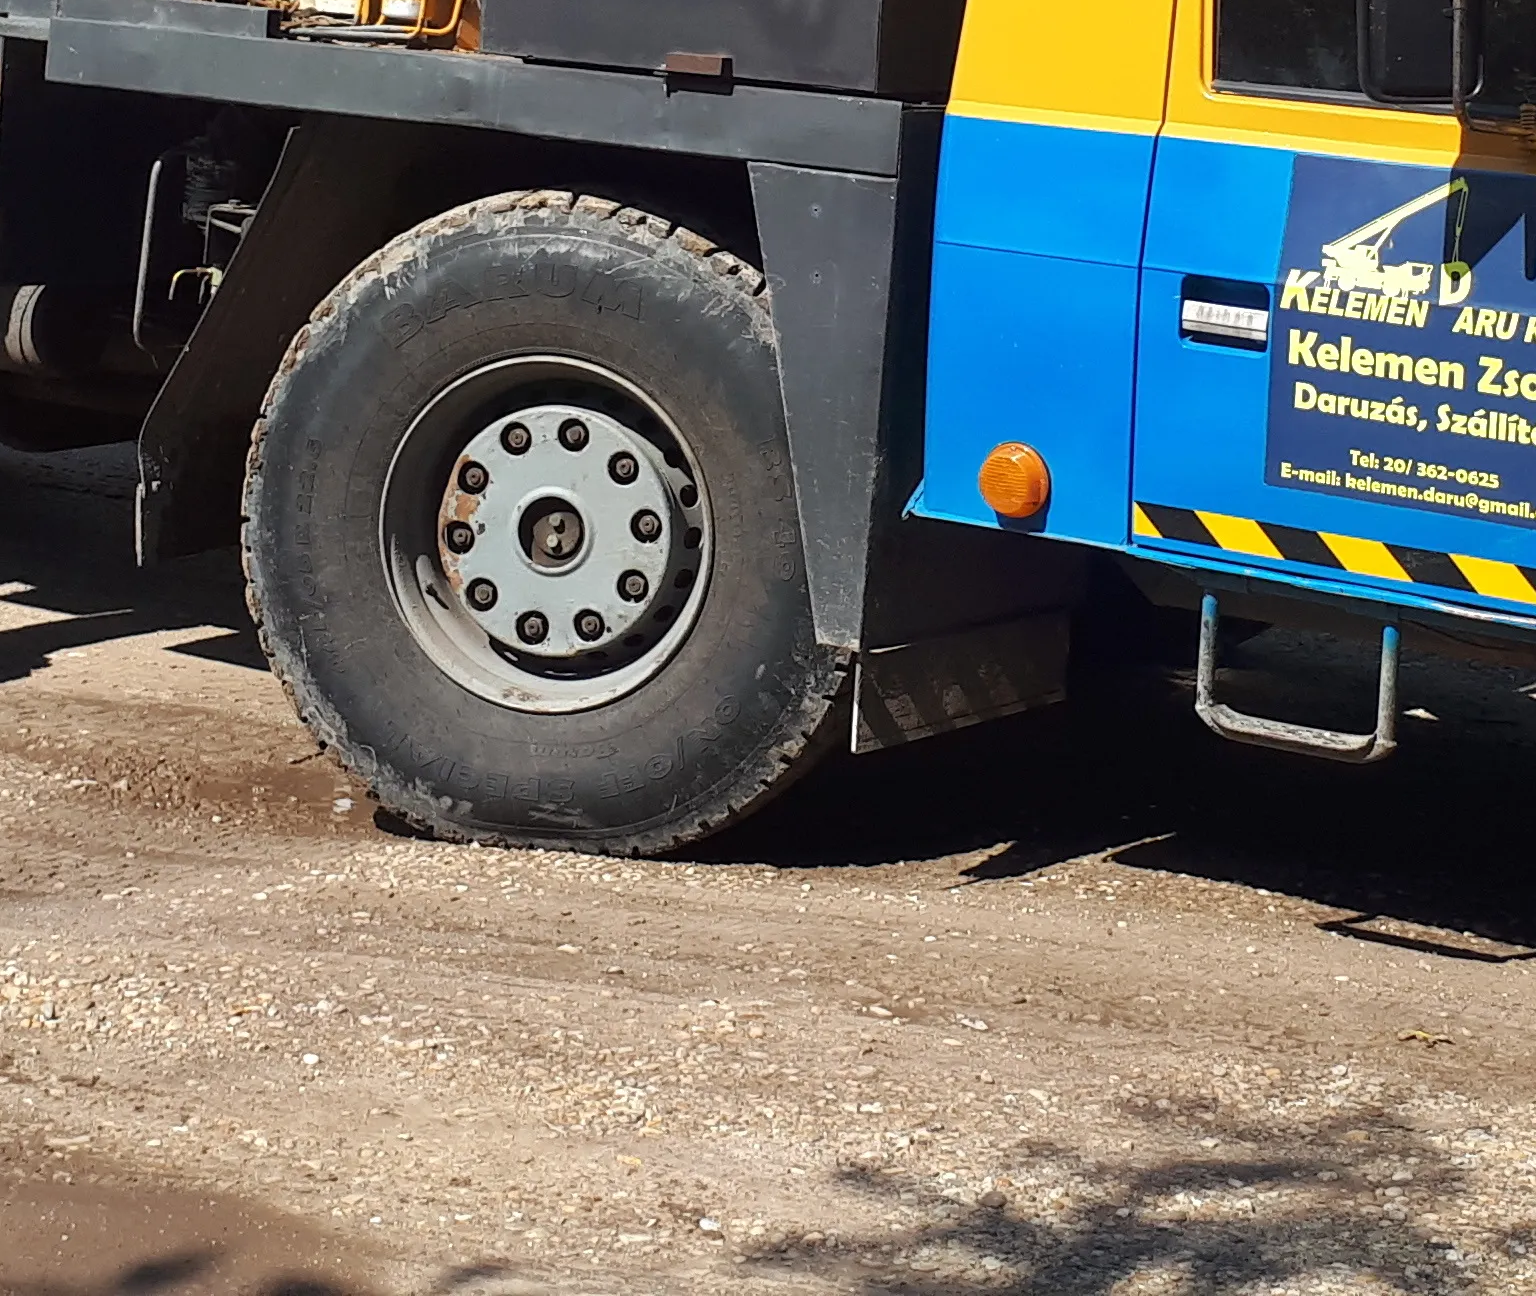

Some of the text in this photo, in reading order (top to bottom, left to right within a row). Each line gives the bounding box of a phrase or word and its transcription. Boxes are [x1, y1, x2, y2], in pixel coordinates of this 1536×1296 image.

[1279, 268, 1430, 328] KELEMEN
[1287, 328, 1465, 390] Kelemen
[1294, 381, 1428, 433] Daruzás,
[1280, 461, 1342, 487] E-mail:
[1349, 449, 1500, 489] Tel: 20/ 362-0625
